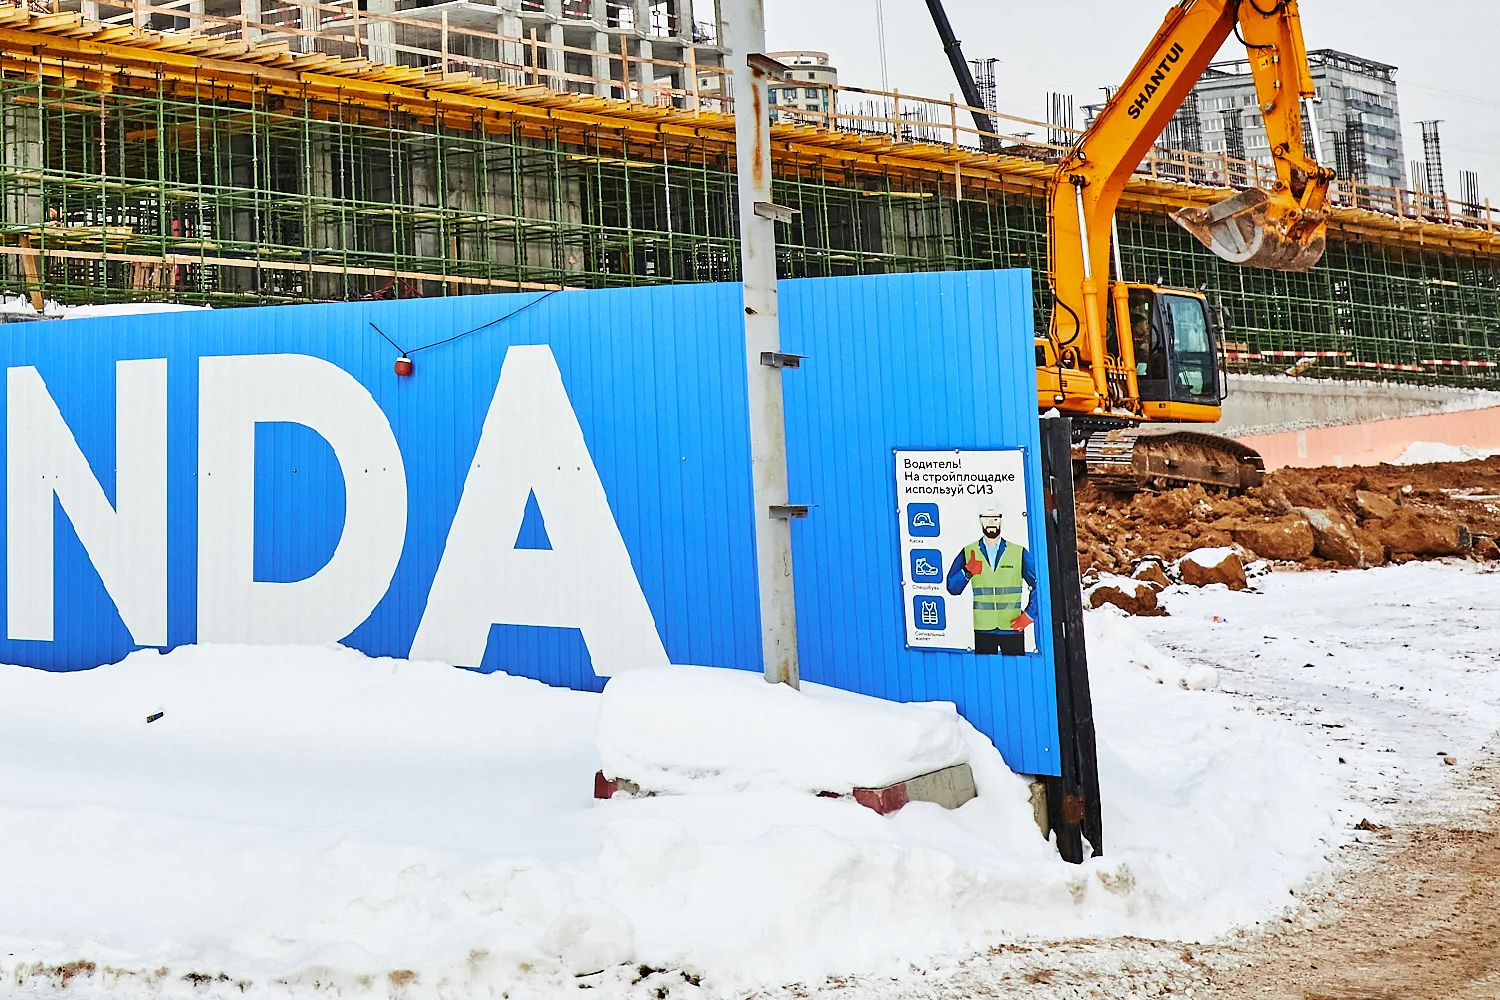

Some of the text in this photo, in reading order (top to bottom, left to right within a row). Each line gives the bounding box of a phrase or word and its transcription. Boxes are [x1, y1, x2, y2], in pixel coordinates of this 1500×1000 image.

[1127, 42, 1185, 120] SHANTUI
[904, 458, 961, 469] Водитель!
[904, 470, 1015, 483] На стройплощадке
[905, 484, 994, 497] используй СИЗ
